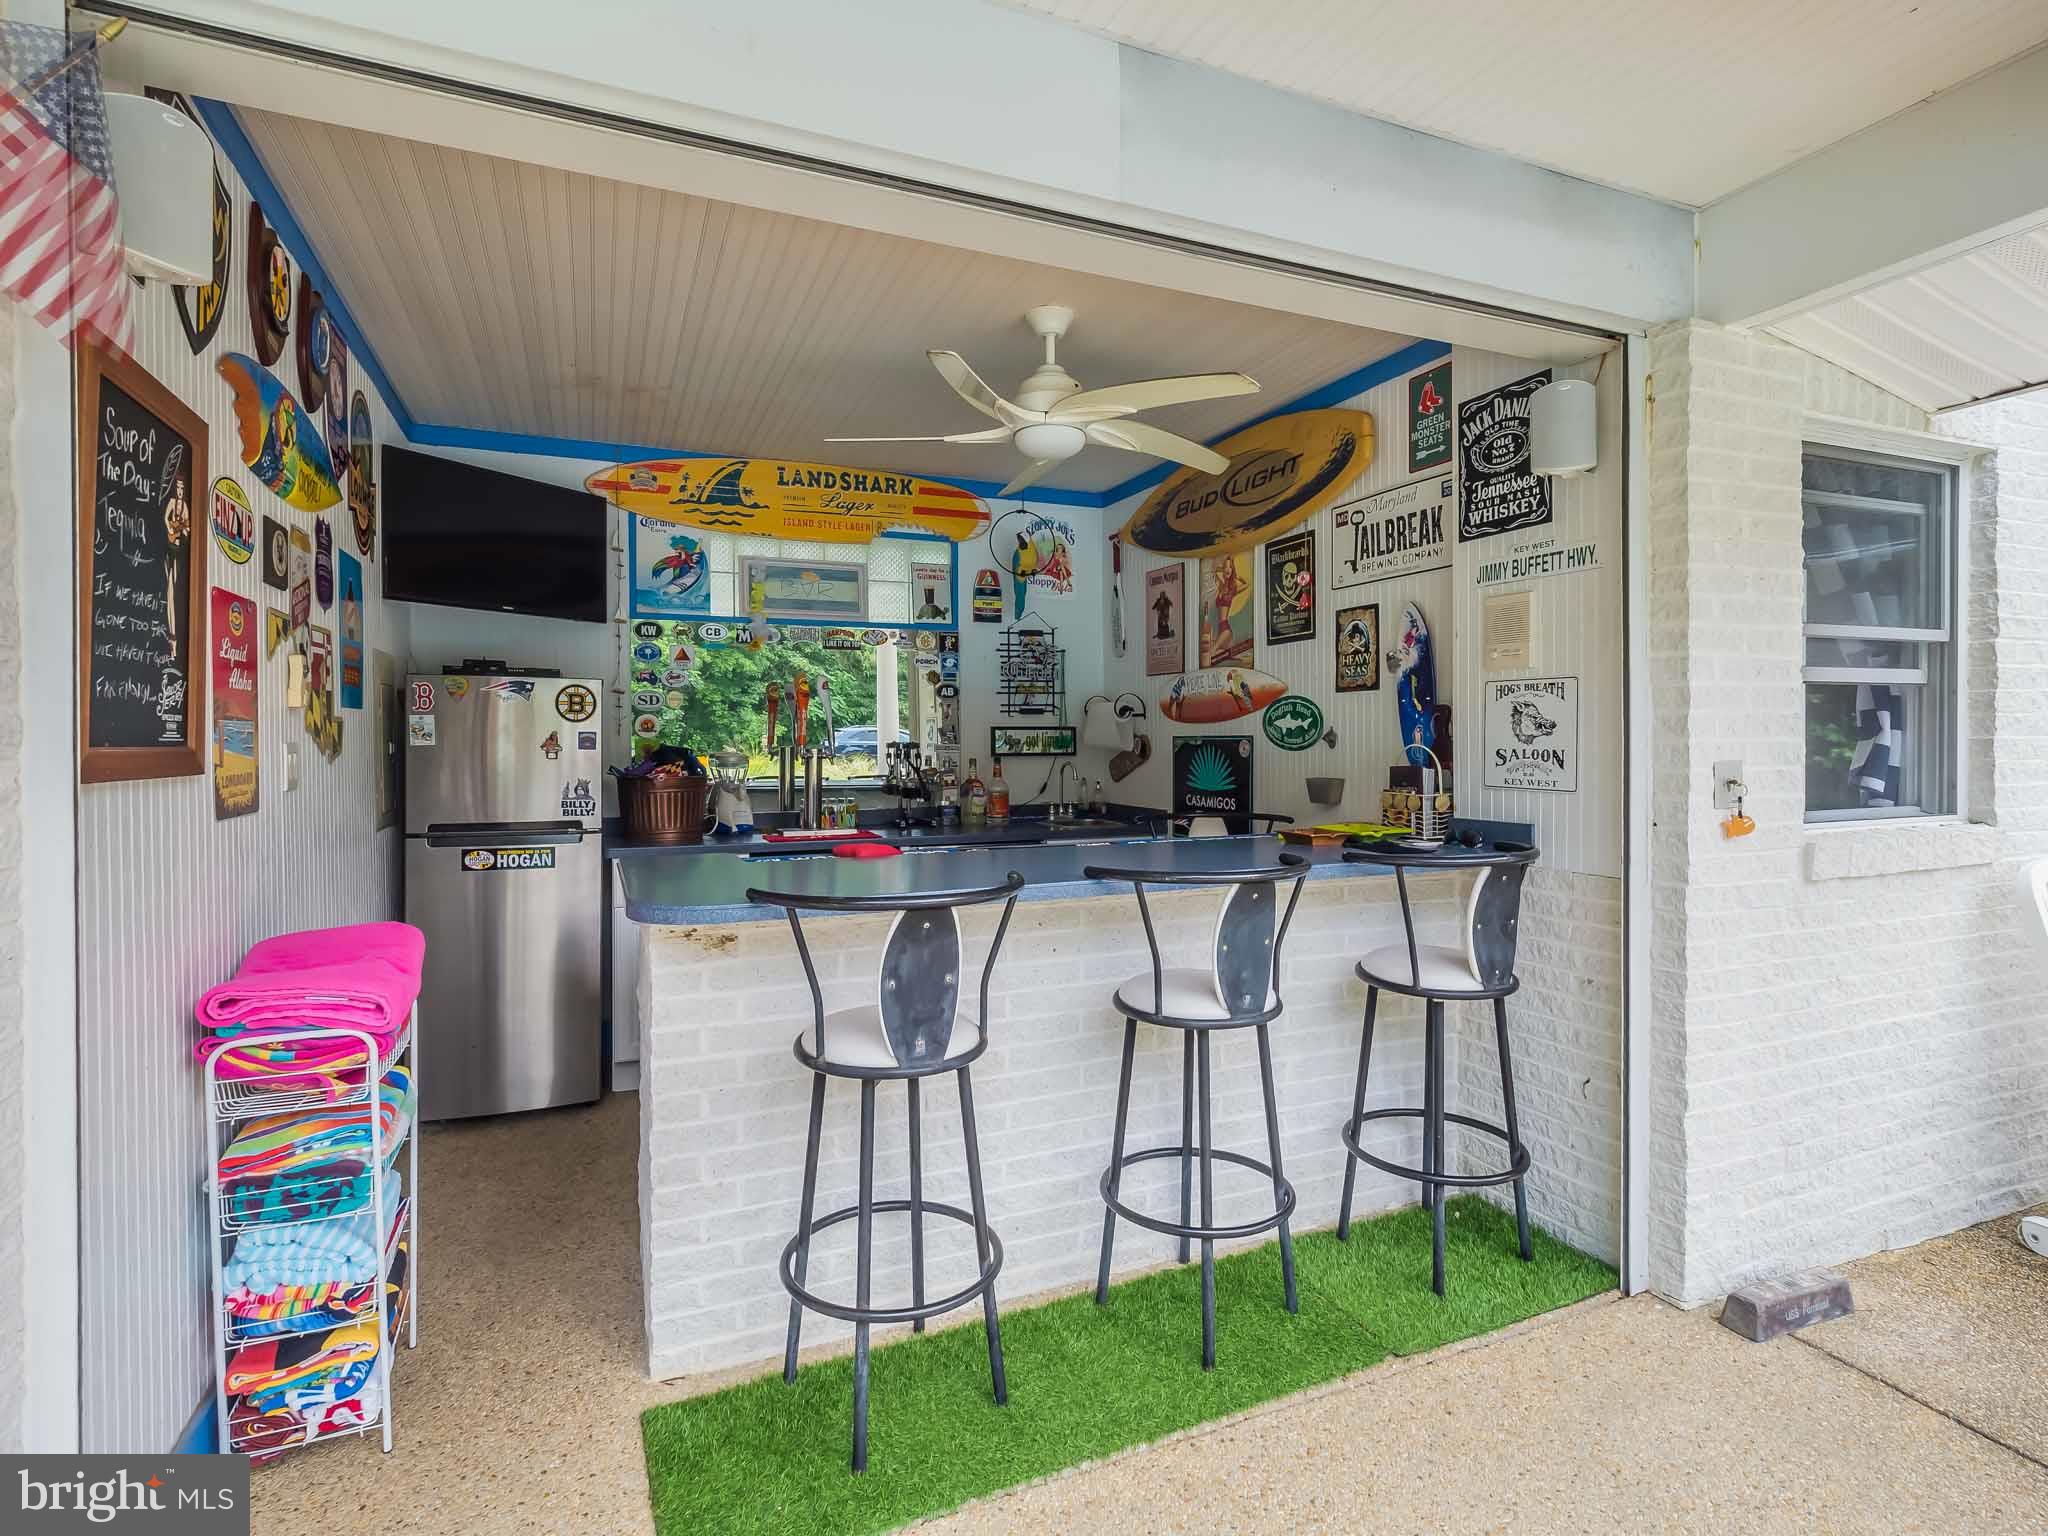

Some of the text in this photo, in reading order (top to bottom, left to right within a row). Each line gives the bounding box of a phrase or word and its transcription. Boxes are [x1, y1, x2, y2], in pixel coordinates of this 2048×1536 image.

[1416, 412, 1444, 429] GREEN
[1462, 408, 1494, 446] JACK
[1484, 420, 1519, 437] OLD TIME
[1411, 420, 1451, 441] MONSTER
[1418, 433, 1443, 449] SEATS
[1493, 435, 1512, 448] Old
[1492, 453, 1514, 464] BRAND
[97, 451, 156, 500] The Day:
[777, 466, 913, 496] LANDSHARK
[1490, 472, 1516, 484] QUALITY
[1174, 453, 1304, 519] BUD LIGHT
[1472, 473, 1538, 502] Tennessee
[820, 492, 875, 516] Lager
[1367, 486, 1418, 513] Maryland
[1471, 485, 1540, 511] SOUR MASH
[1468, 494, 1541, 525] WHISKEY
[241, 511, 253, 546] UP
[784, 518, 814, 528] ISLAND
[817, 519, 842, 530] STYLE
[1514, 539, 1555, 554] KEY WEST
[1362, 557, 1399, 573] BREWING
[1402, 547, 1444, 565] COMPANY
[1476, 544, 1598, 585] JIMMY BUFFETT HWY.
[1027, 575, 1057, 590] Sloppy
[640, 625, 657, 636] KW
[705, 627, 722, 637] CB
[219, 637, 248, 668] Liquid
[1342, 653, 1371, 666] HEAVY
[1344, 664, 1369, 676] SEAS
[229, 670, 252, 690] Aloha
[412, 681, 435, 712] B
[637, 694, 660, 706] SD
[941, 687, 954, 696] AB
[1524, 682, 1566, 701] BREATH
[567, 694, 585, 713] B
[1271, 704, 1293, 719] Dogfish
[1495, 748, 1566, 770] SALOON
[1503, 777, 1559, 789] KEY WEST
[560, 800, 591, 809] BILLY
[1185, 794, 1236, 811] CASAMIGOS
[496, 853, 552, 868] HOGAN
